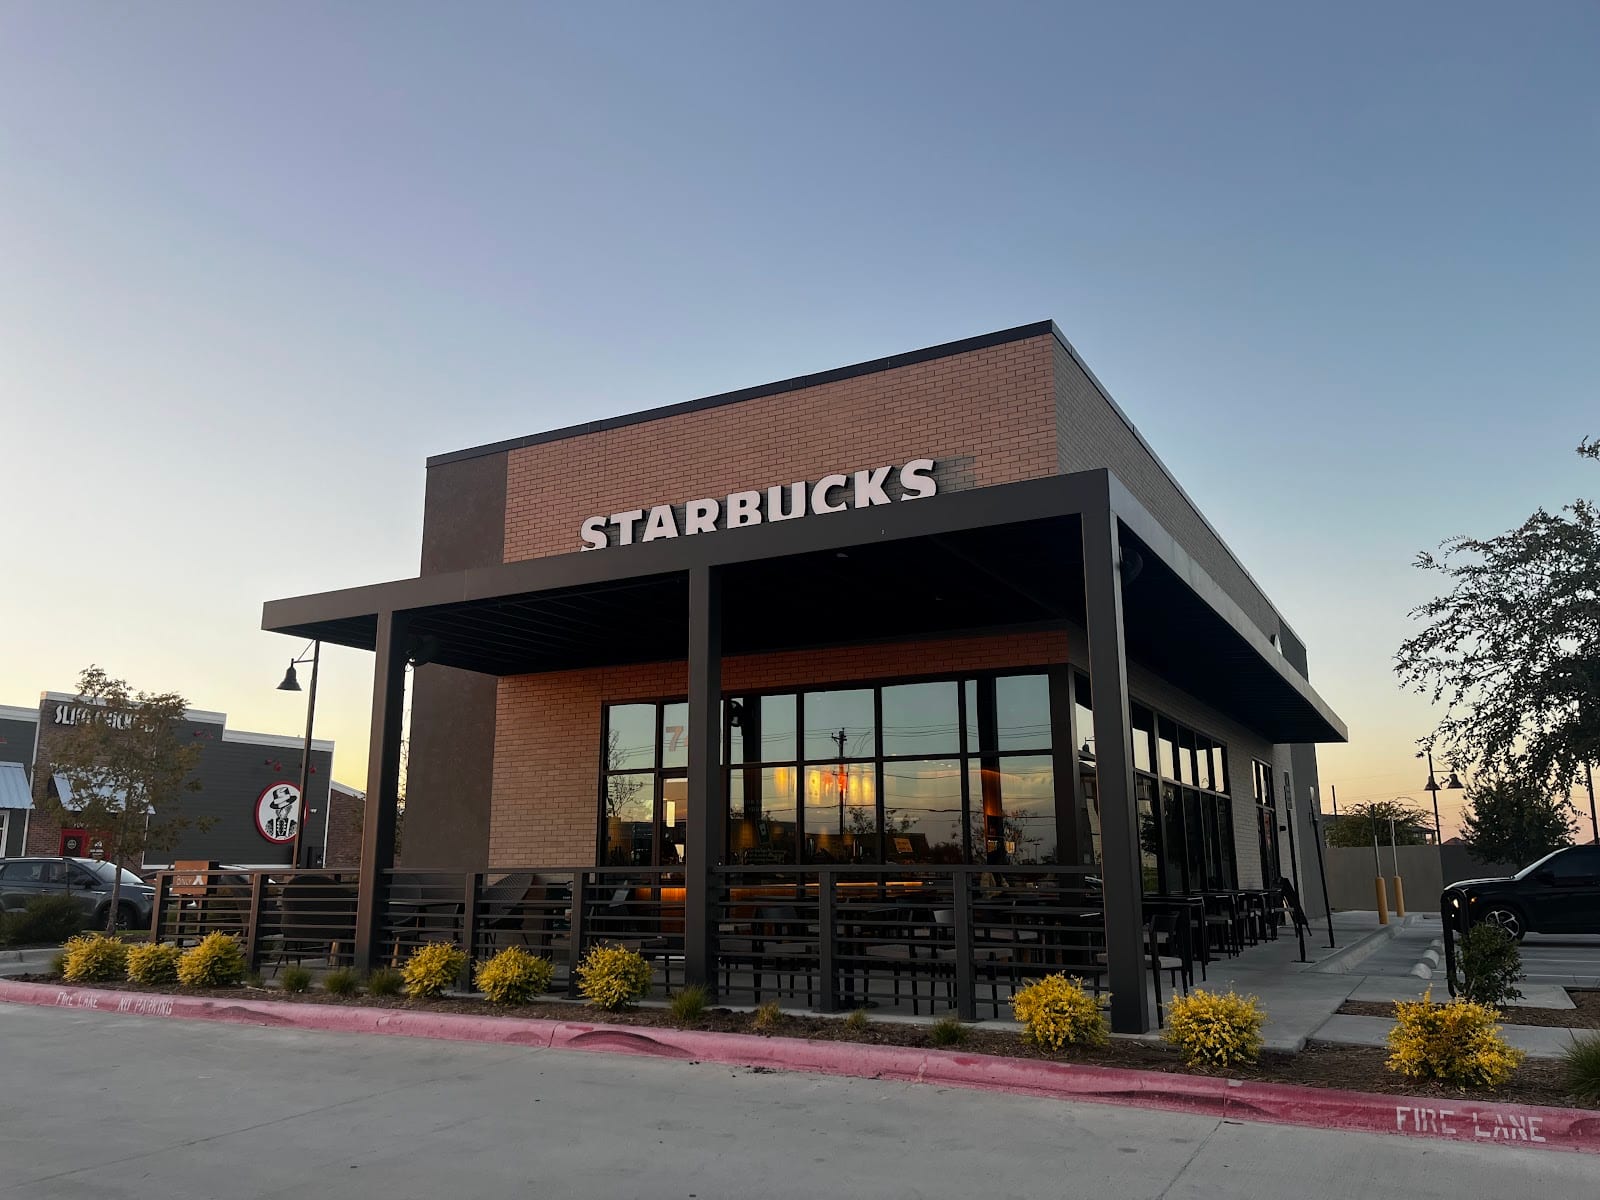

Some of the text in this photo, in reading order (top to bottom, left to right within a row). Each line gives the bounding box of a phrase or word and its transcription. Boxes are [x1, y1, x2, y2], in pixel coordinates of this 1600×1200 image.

[580, 459, 937, 551] STARBUCKS
[1396, 1106, 1546, 1143] FIRE LANE
